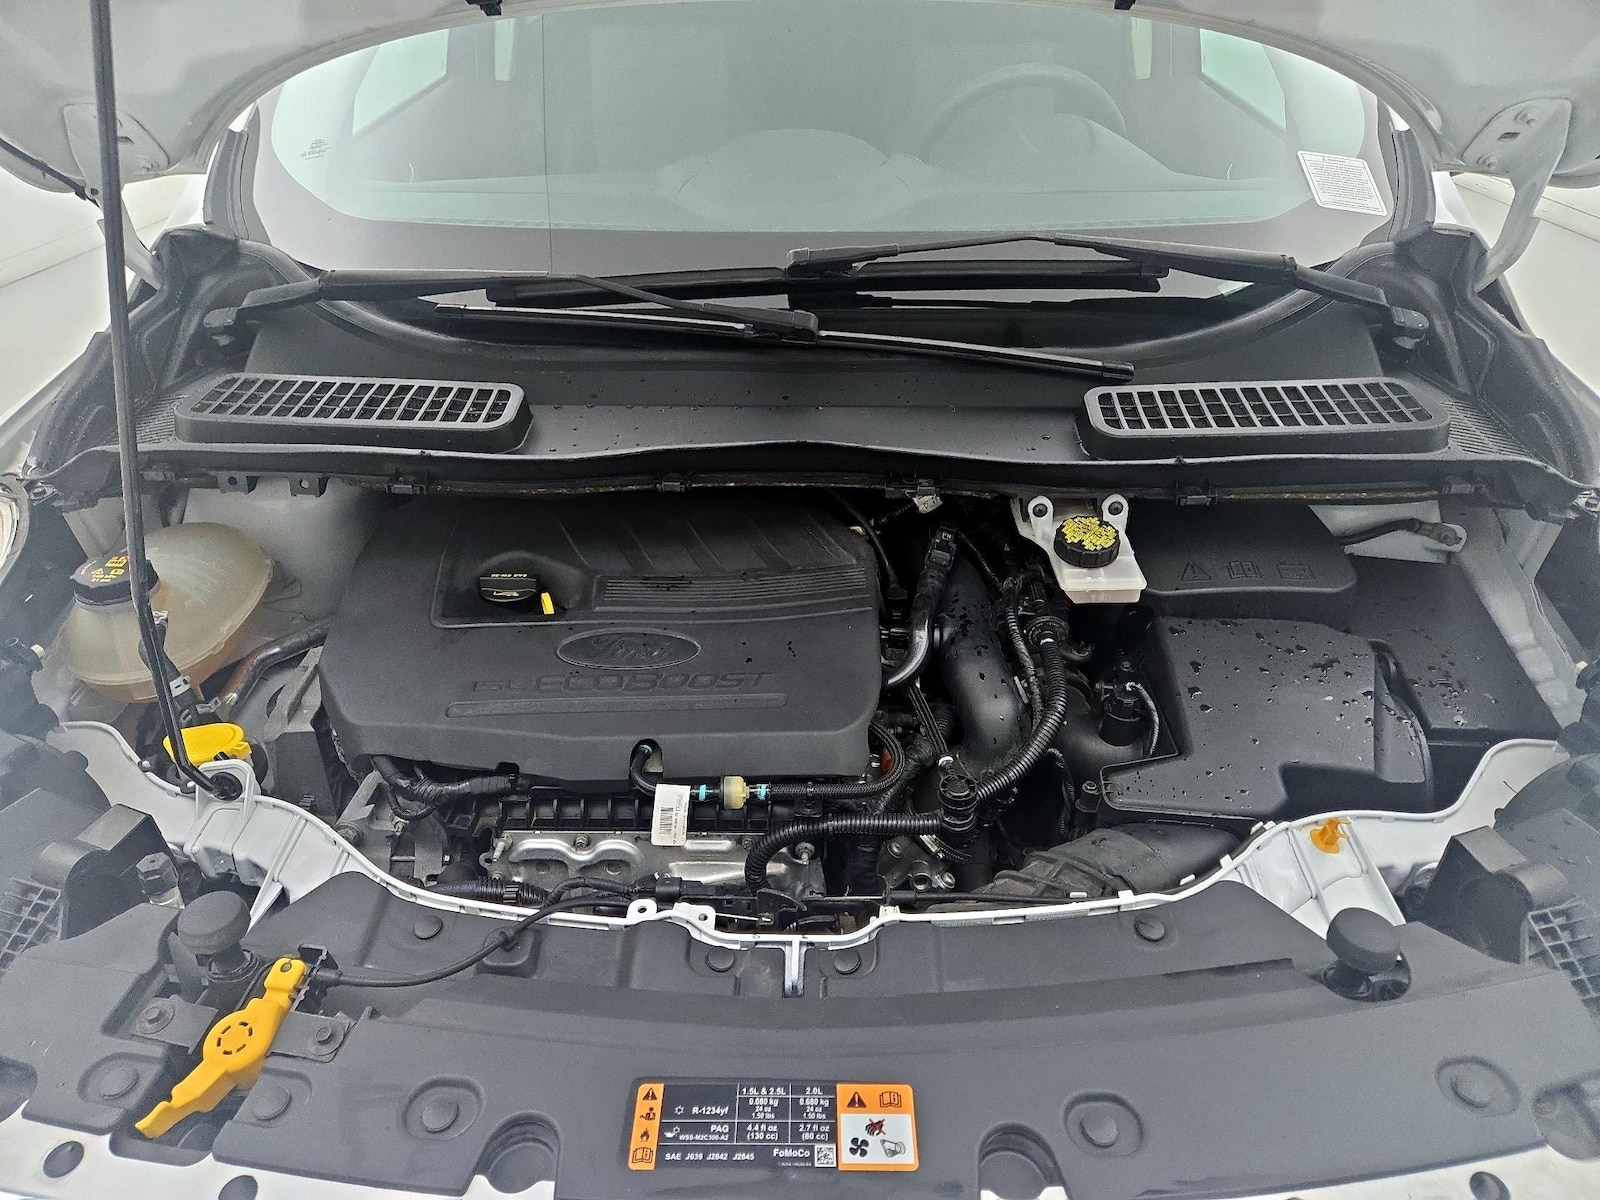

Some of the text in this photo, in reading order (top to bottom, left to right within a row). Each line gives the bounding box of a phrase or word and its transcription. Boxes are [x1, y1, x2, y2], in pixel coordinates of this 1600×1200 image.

[742, 1087, 786, 1095] 1.5L & 2.5L
[805, 1087, 823, 1095] 2.0L
[769, 1098, 779, 1107] kg
[820, 1098, 829, 1107] kg
[692, 1106, 729, 1116] R-1234yf
[710, 1124, 729, 1133] PAG
[746, 1124, 759, 1132] 4.4
[760, 1124, 766, 1132] fl
[799, 1124, 810, 1132] 2.7
[812, 1124, 818, 1132] fl
[747, 1132, 778, 1140] (130 cc)
[816, 1132, 828, 1140] cc)
[664, 1152, 755, 1160] SAE J639 J2842 J2845
[773, 1148, 811, 1157] FoMoCo
